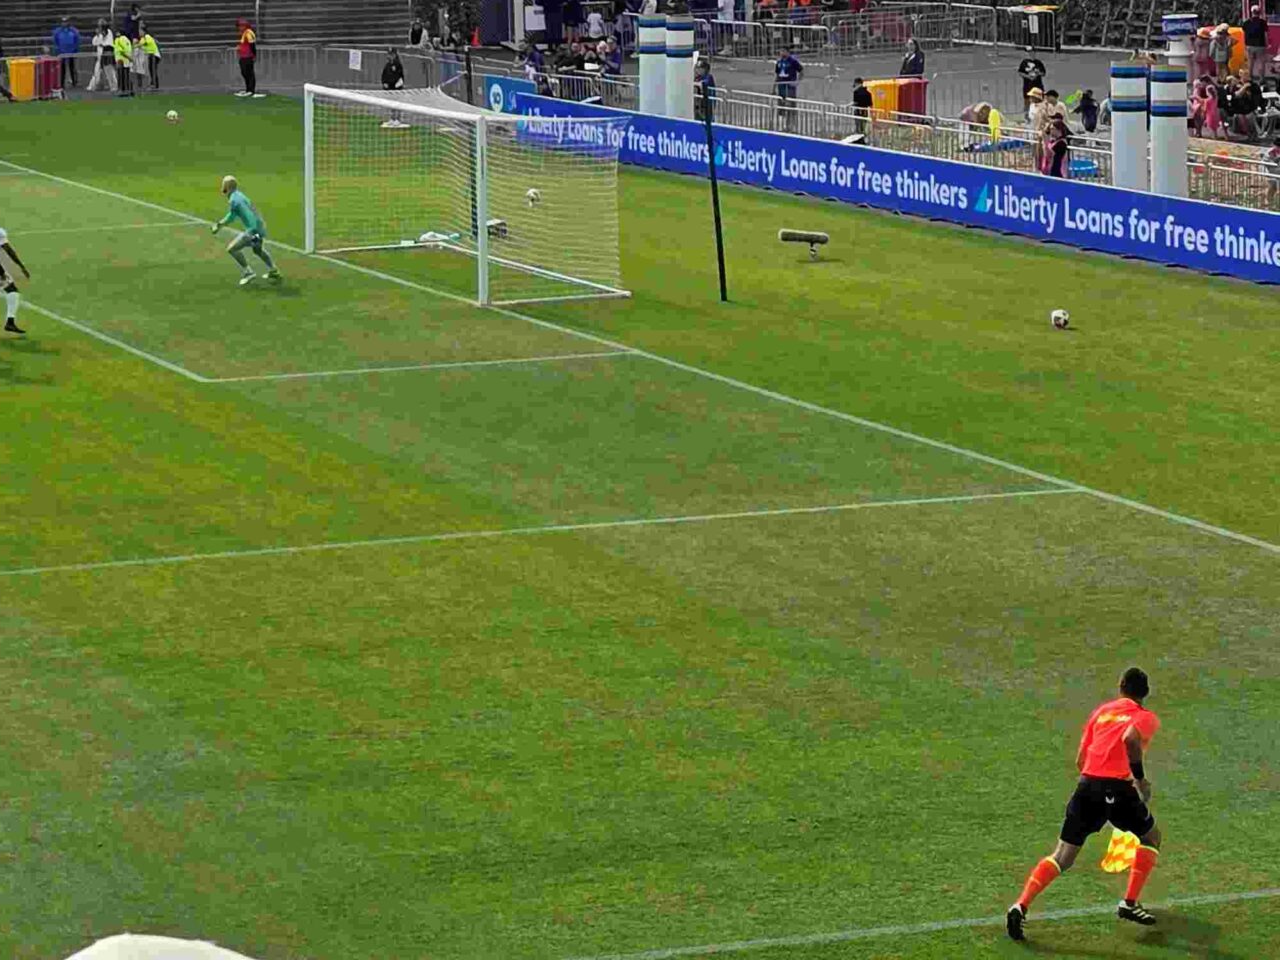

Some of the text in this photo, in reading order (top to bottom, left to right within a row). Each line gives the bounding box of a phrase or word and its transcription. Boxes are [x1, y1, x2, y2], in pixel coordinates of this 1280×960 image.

[528, 107, 710, 164] Liberty Loans for free thinkers
[727, 140, 968, 210] Liberty Loans for free thinkers
[994, 185, 1058, 233] Liberty
[1064, 197, 1124, 238] Loans
[1128, 208, 1161, 244] for
[1164, 215, 1209, 254] free
